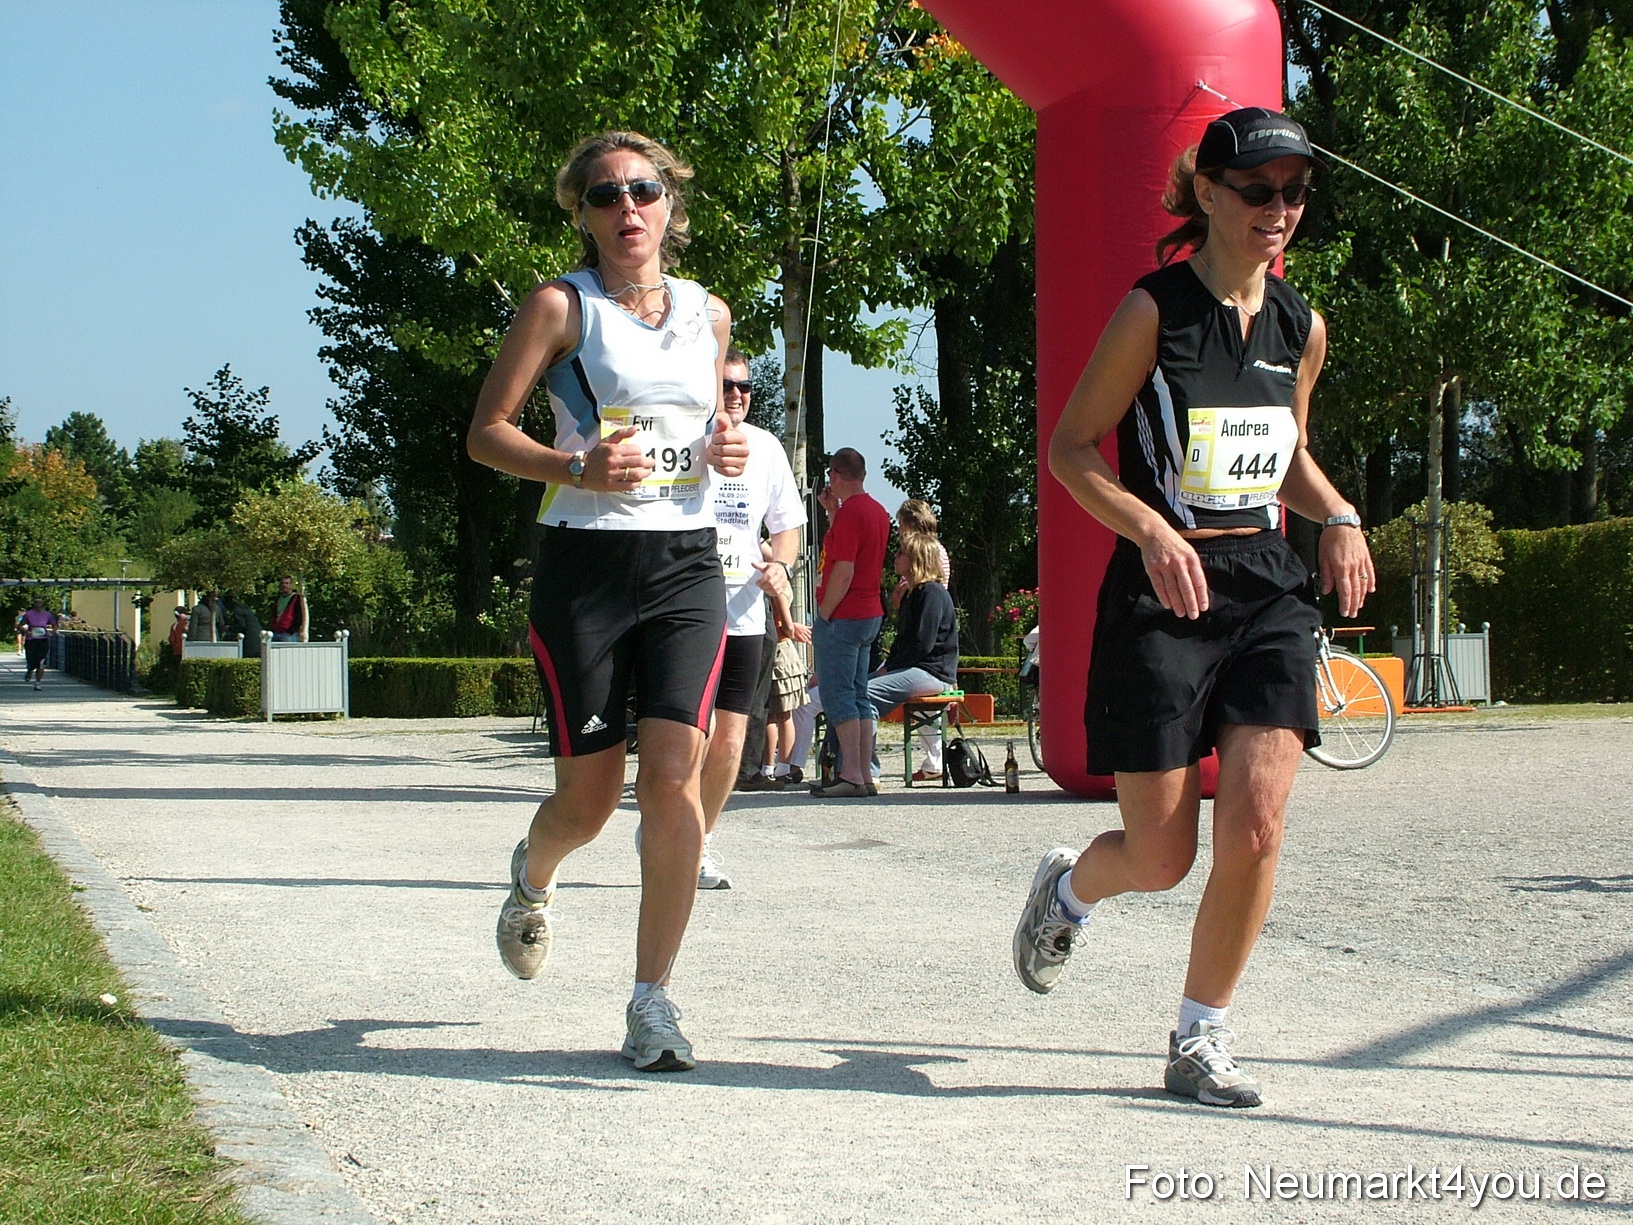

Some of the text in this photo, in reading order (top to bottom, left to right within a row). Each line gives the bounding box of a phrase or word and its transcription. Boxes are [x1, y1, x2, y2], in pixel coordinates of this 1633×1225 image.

[632, 415, 653, 432] Evi
[1221, 418, 1269, 437] Andrea
[645, 447, 692, 473] 193
[1191, 448, 1200, 462] D
[1228, 452, 1278, 480] 444
[581, 723, 608, 734] adidas
